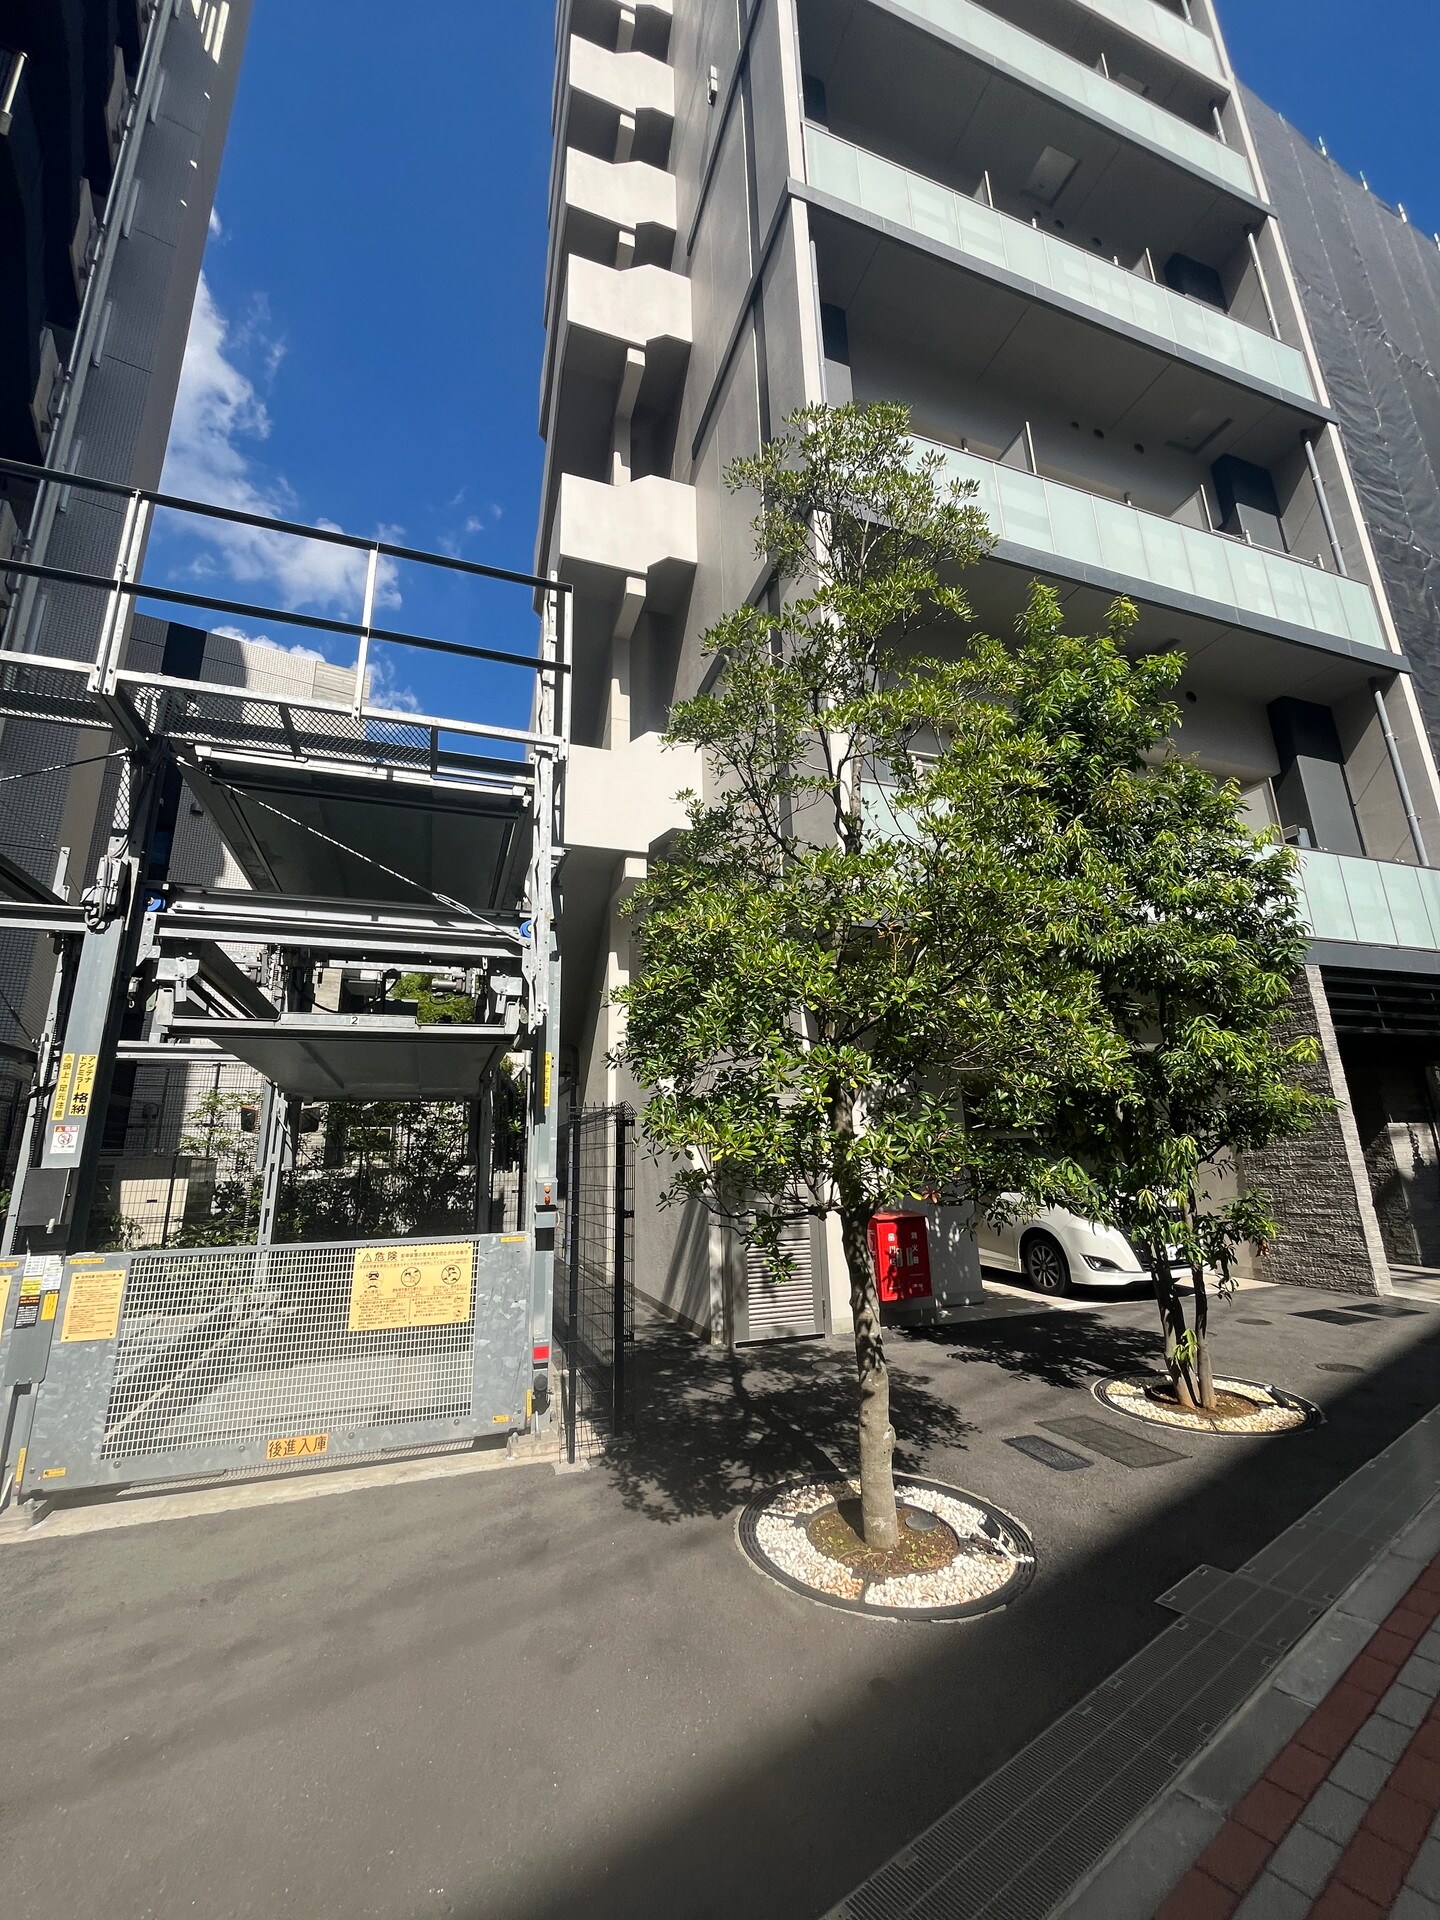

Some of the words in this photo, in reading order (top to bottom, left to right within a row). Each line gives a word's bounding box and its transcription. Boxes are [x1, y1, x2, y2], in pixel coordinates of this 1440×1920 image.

[351, 1016, 358, 1025] 2
[76, 1055, 88, 1091] ドアミラー
[85, 1056, 96, 1084] アンテナ
[70, 1092, 88, 1115] 格納
[374, 1251, 397, 1262] 危険
[268, 1435, 327, 1458] 後進入庫
